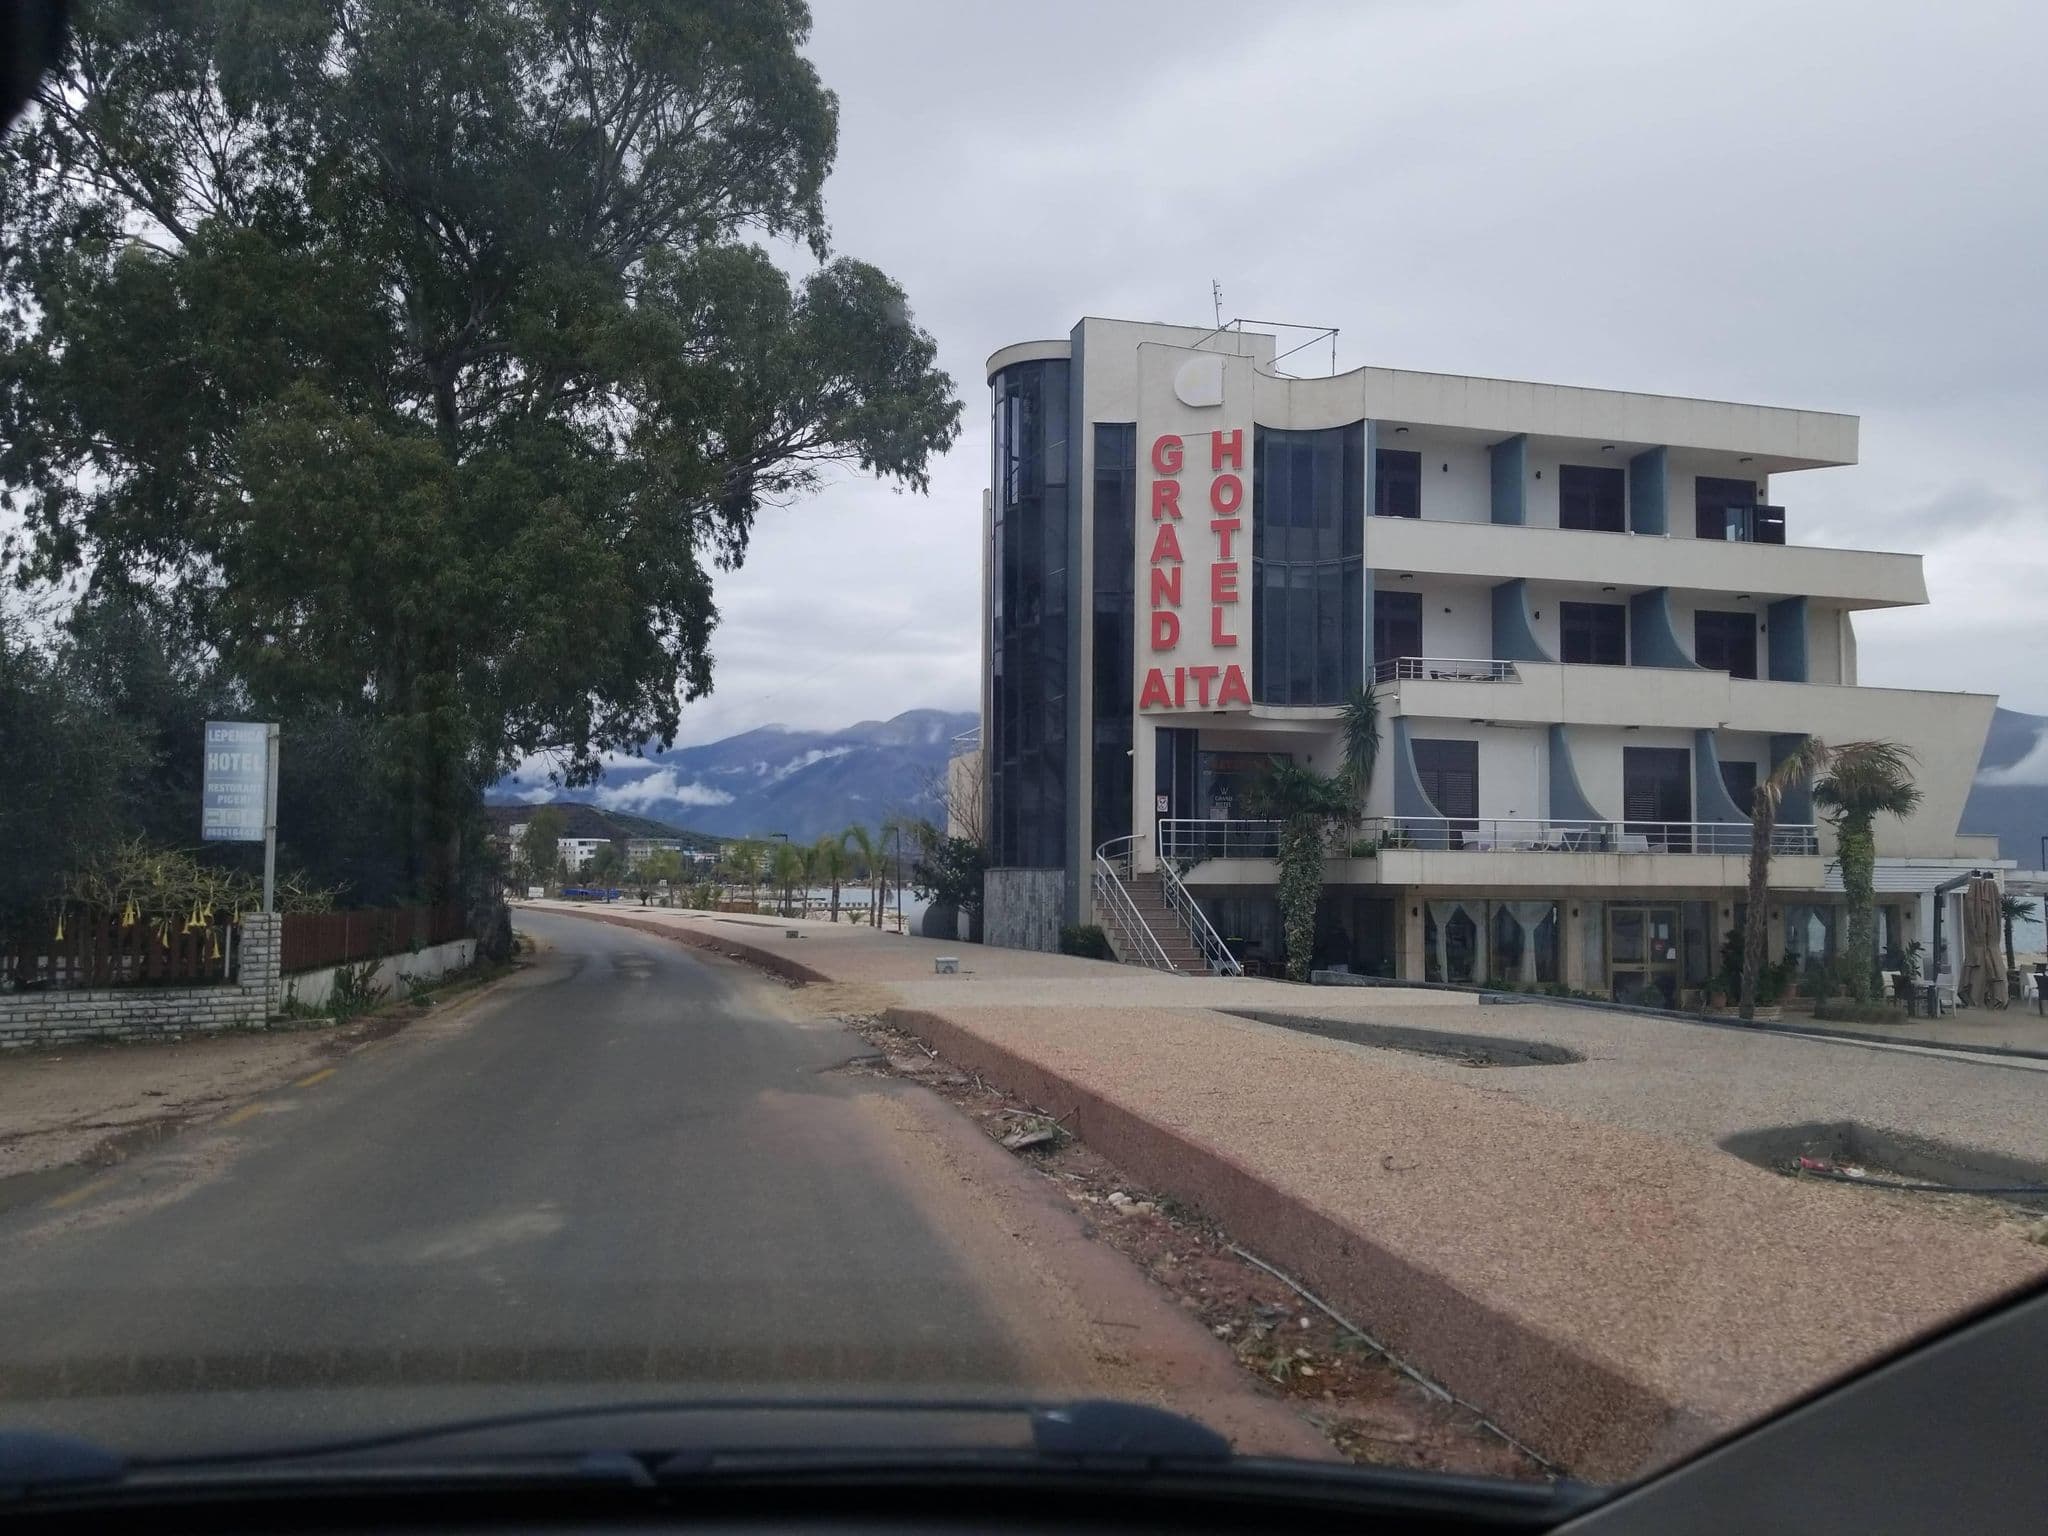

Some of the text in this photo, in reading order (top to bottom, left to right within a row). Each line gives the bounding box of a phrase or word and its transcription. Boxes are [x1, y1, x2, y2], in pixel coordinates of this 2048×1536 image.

[1151, 434, 1183, 650] GRAND
[1210, 429, 1243, 647] HOTEL
[1139, 664, 1250, 708] AITA
[207, 752, 263, 771] HOTEL
